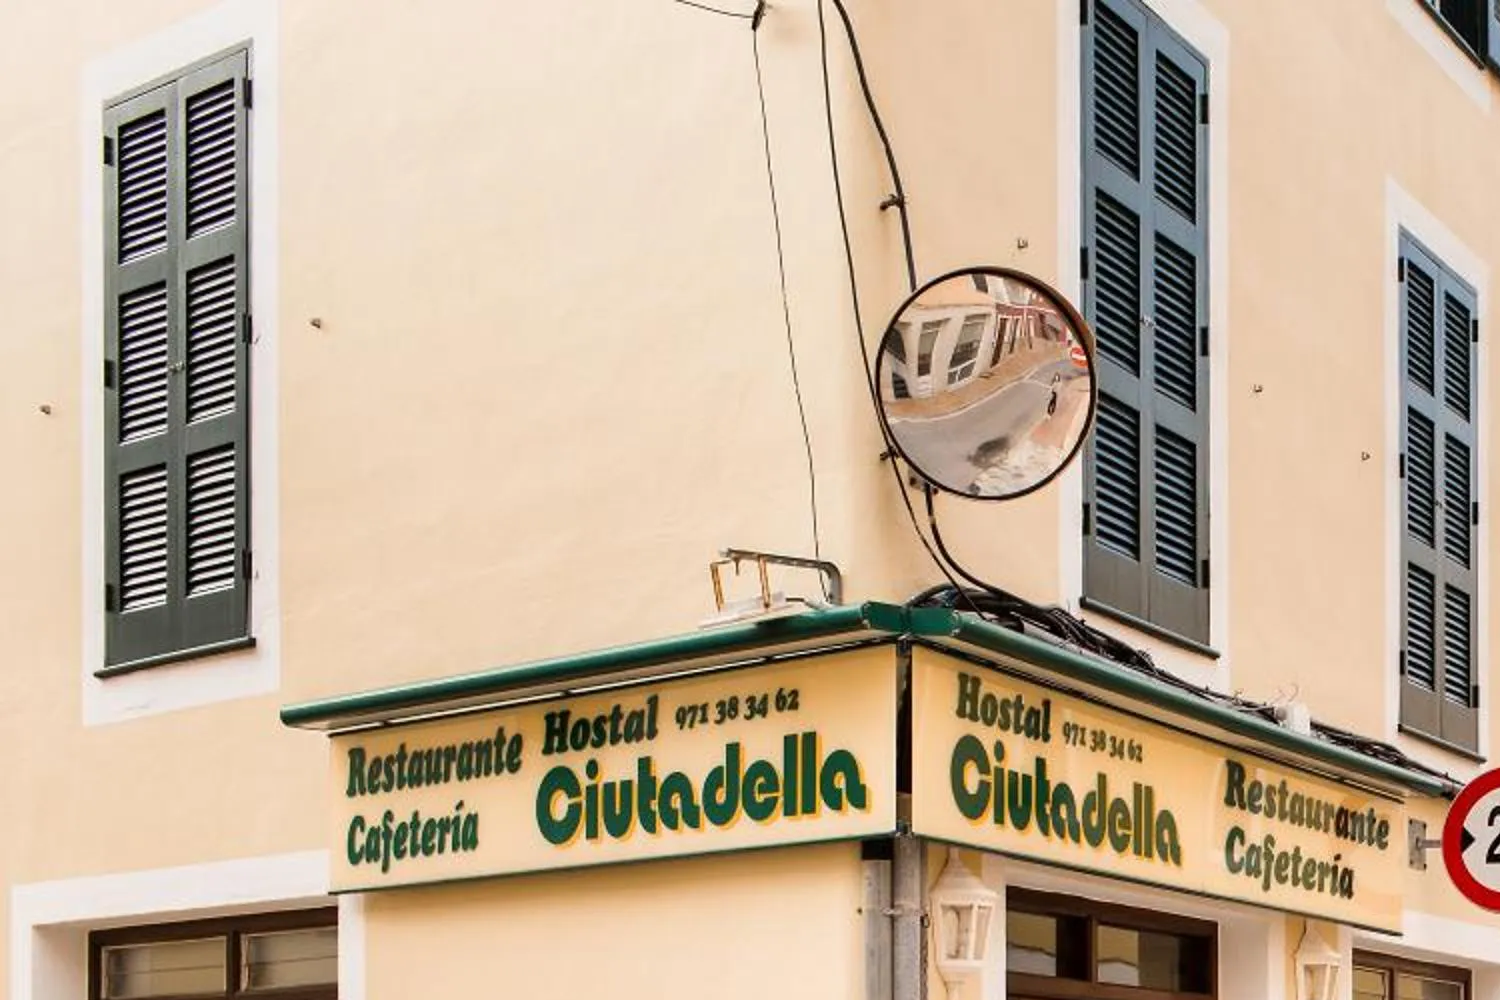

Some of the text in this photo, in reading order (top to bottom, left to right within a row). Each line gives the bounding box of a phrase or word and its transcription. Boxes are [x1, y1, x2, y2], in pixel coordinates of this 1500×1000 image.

[541, 688, 800, 755] Hostal 971 38 34 62
[956, 672, 1144, 763] Hostal 971 38 34 62
[346, 726, 523, 798] Restaurante
[536, 731, 867, 845] Ciutadella
[950, 734, 1182, 867] Ciutadella
[347, 800, 479, 874] Cafetería
[1224, 759, 1390, 850] Restaurante
[1225, 825, 1354, 900] Cafetería
